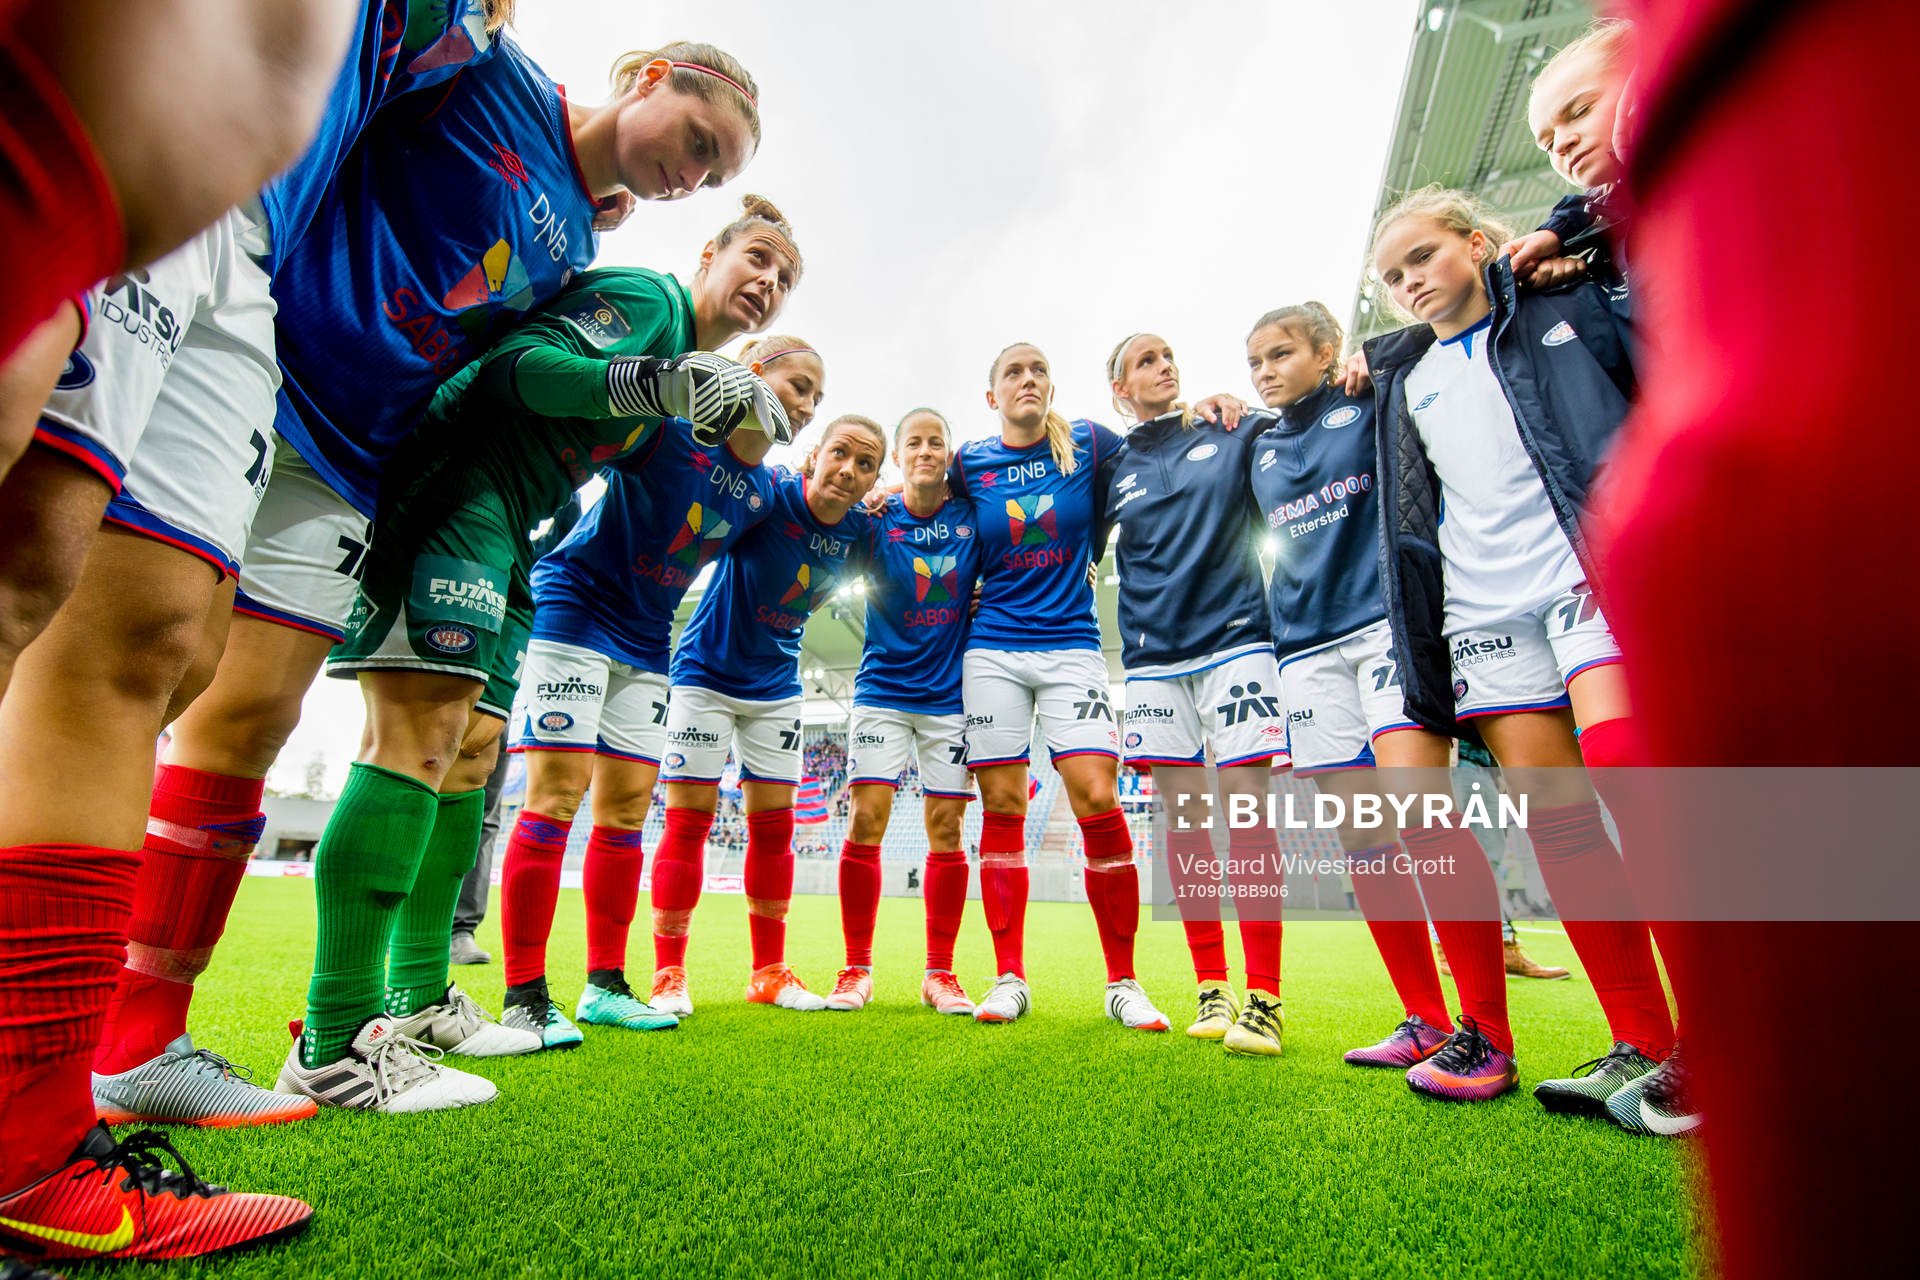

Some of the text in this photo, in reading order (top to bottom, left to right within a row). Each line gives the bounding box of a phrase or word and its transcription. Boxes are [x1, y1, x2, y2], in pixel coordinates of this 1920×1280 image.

[489, 158, 520, 191] umbro
[528, 193, 568, 262] DNB
[709, 465, 748, 499] DNB
[1007, 461, 1047, 486] DNB
[1268, 473, 1373, 530] REMA 1000
[914, 520, 949, 545] DNB
[1290, 504, 1349, 538] Etterstad
[809, 532, 841, 557] DNB
[1003, 547, 1073, 569] SABONA
[903, 608, 960, 628] SABON
[1454, 648, 1517, 669] NDUSTRIES
